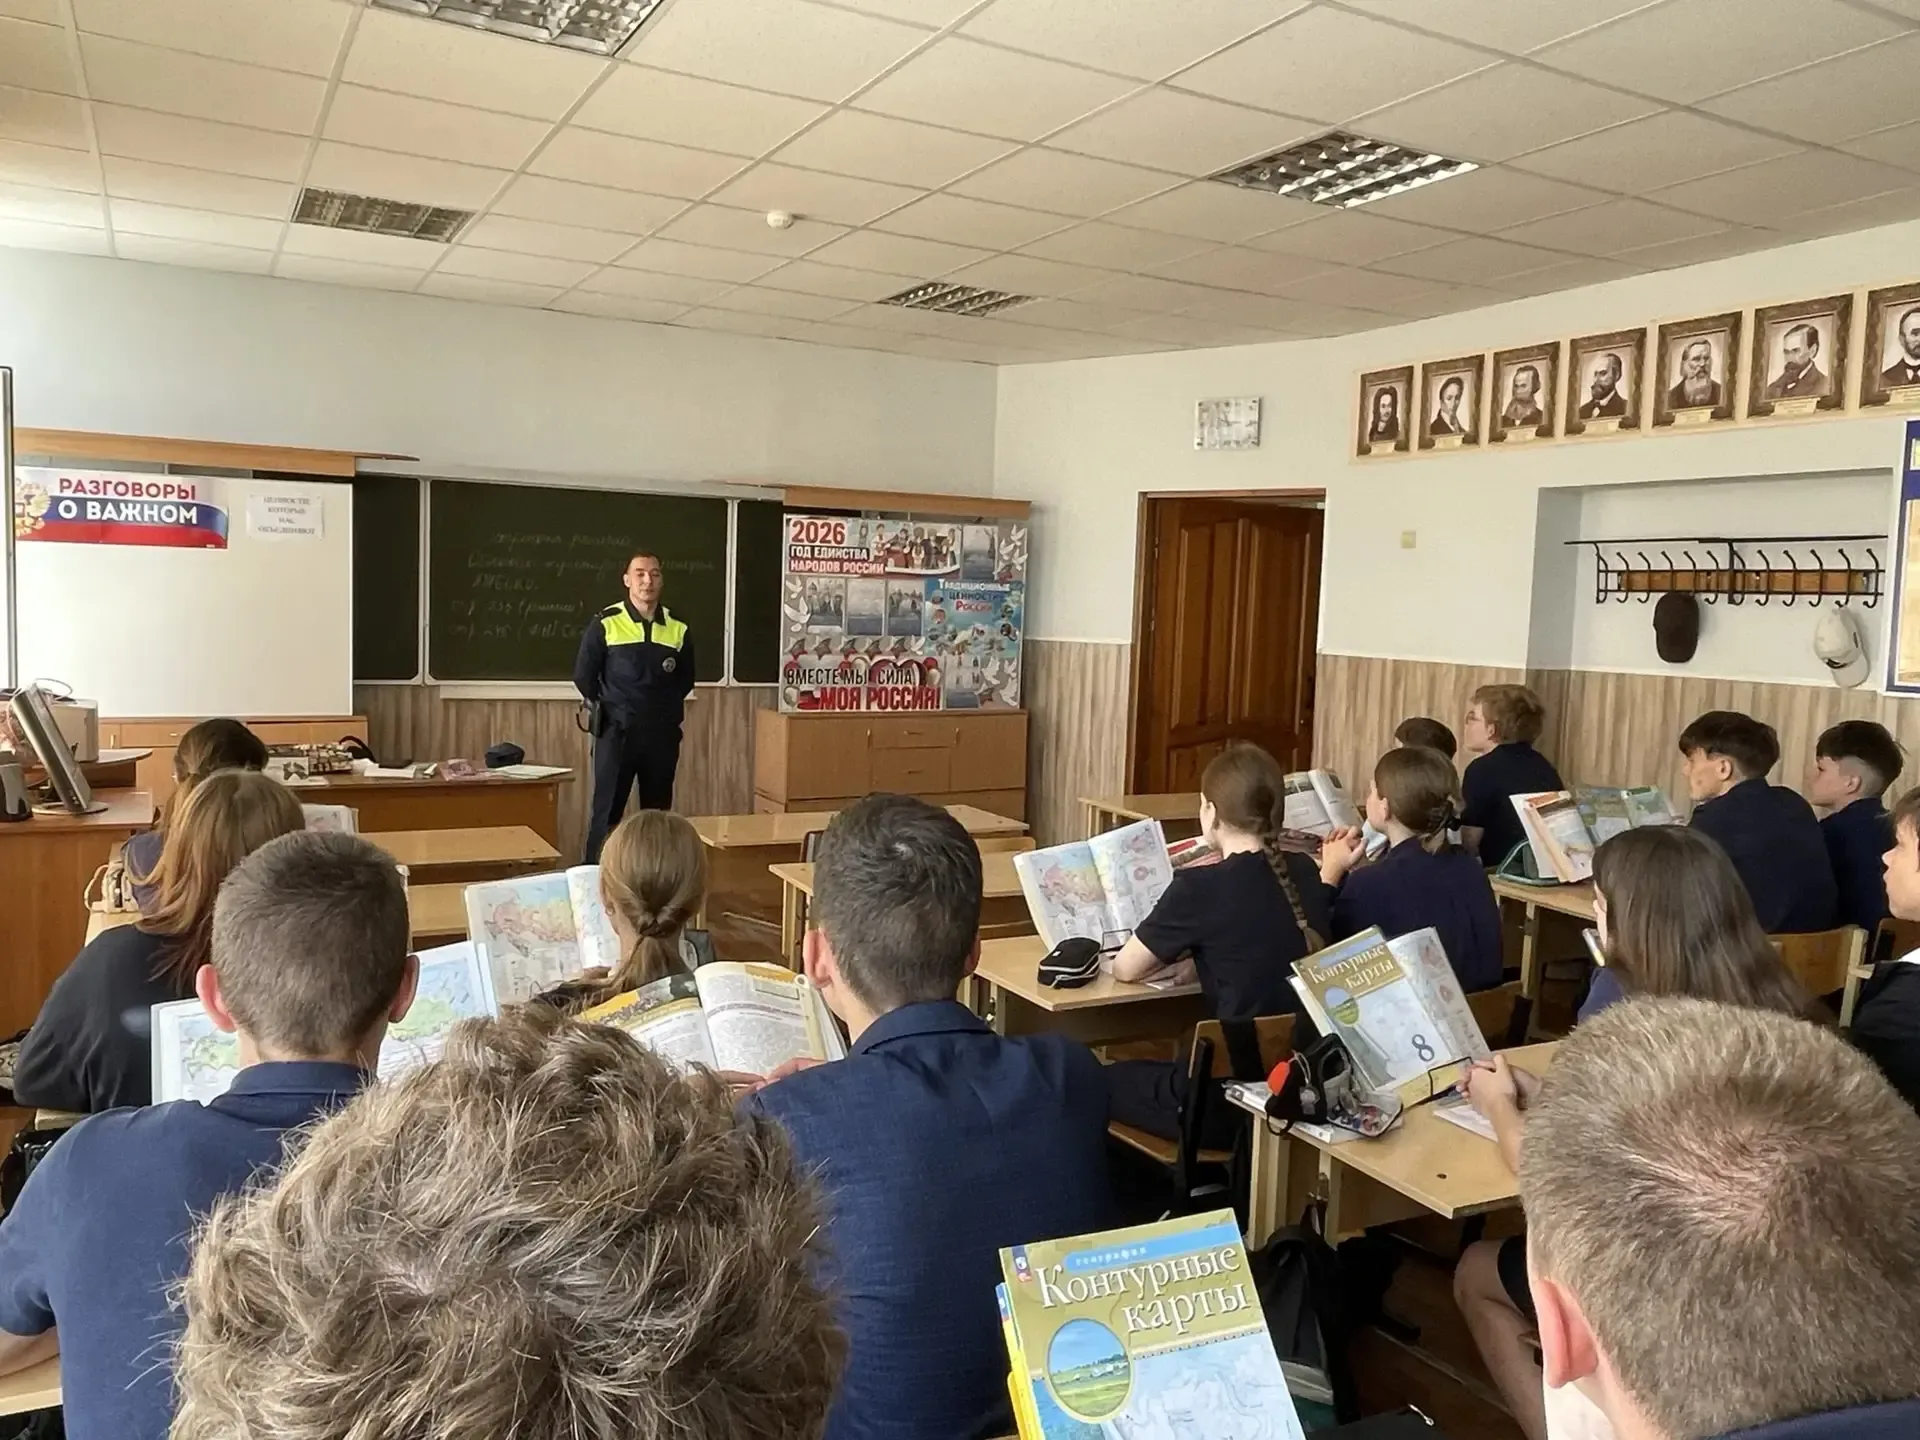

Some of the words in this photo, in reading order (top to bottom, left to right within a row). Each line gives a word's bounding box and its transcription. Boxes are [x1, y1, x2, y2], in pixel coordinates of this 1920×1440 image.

[59, 478, 196, 500] РАЗГОВОРЫ
[58, 500, 77, 520] О
[87, 501, 197, 525] ВАЖНОМ
[791, 520, 845, 545] 2026
[791, 546, 811, 558] ГОД
[814, 547, 868, 560] ЕДИНСТВА
[790, 560, 840, 573] НАРОДОВ
[843, 562, 884, 574] РОССИИ
[786, 668, 838, 685] ВМЕСТЕ
[843, 669, 867, 685] МЫ
[820, 686, 861, 710] МОЯ
[866, 686, 941, 710] РОССИЯ!
[1307, 944, 1385, 984] Контурные
[1345, 959, 1394, 989] карты
[1412, 1034, 1435, 1062] 8
[1034, 1247, 1240, 1309] Контурные
[1121, 1283, 1251, 1335] карты
